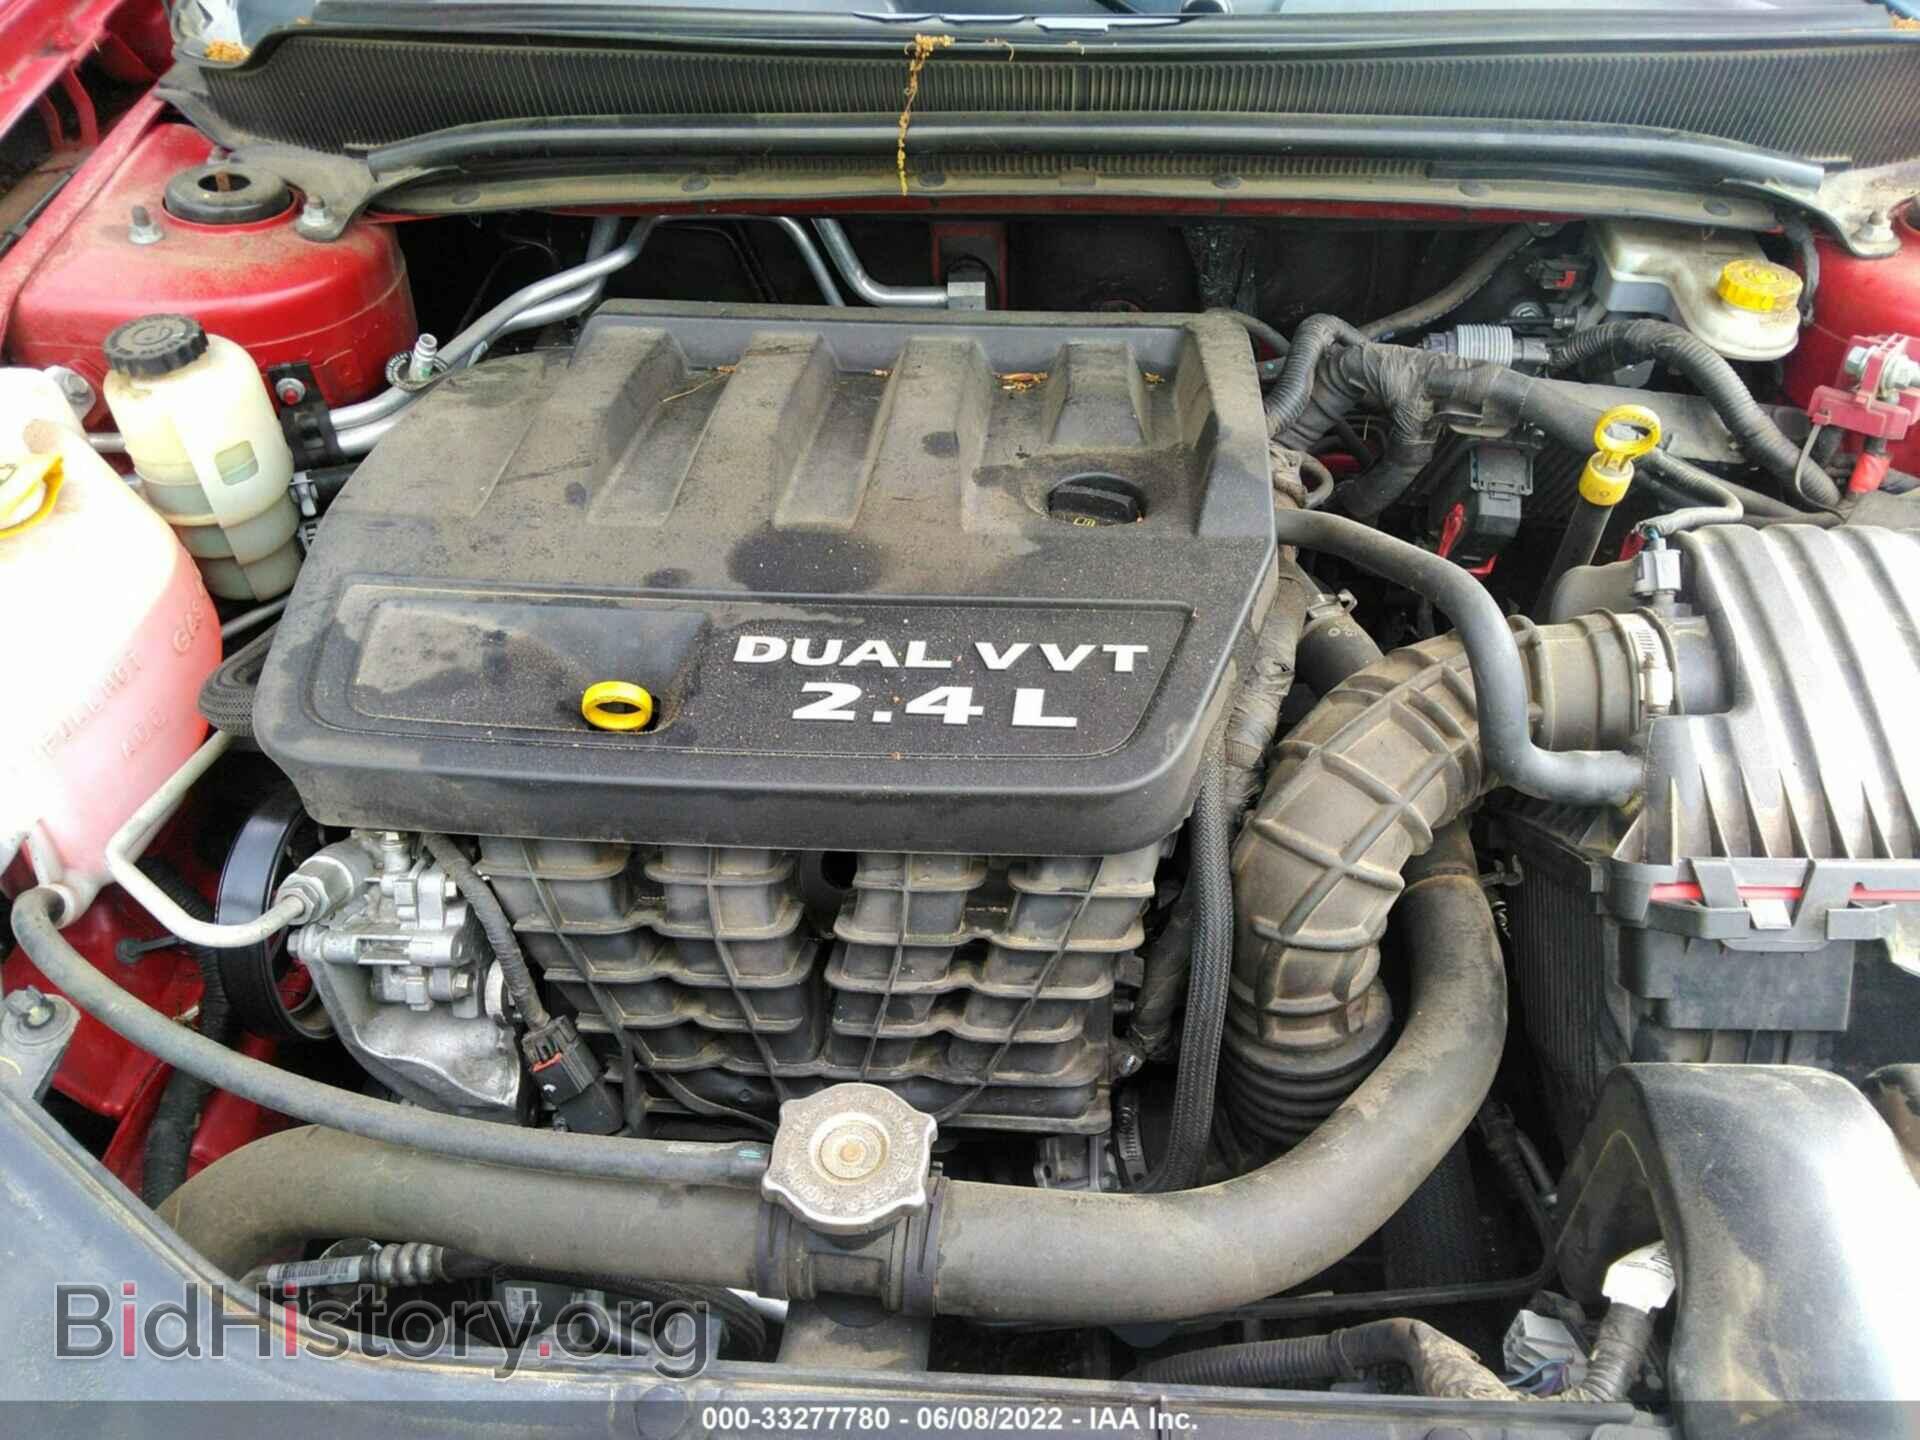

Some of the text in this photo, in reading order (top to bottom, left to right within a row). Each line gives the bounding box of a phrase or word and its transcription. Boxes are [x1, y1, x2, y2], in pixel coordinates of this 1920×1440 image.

[733, 635, 1149, 672] DUAL VVT
[791, 681, 1078, 729] 2.4 L
